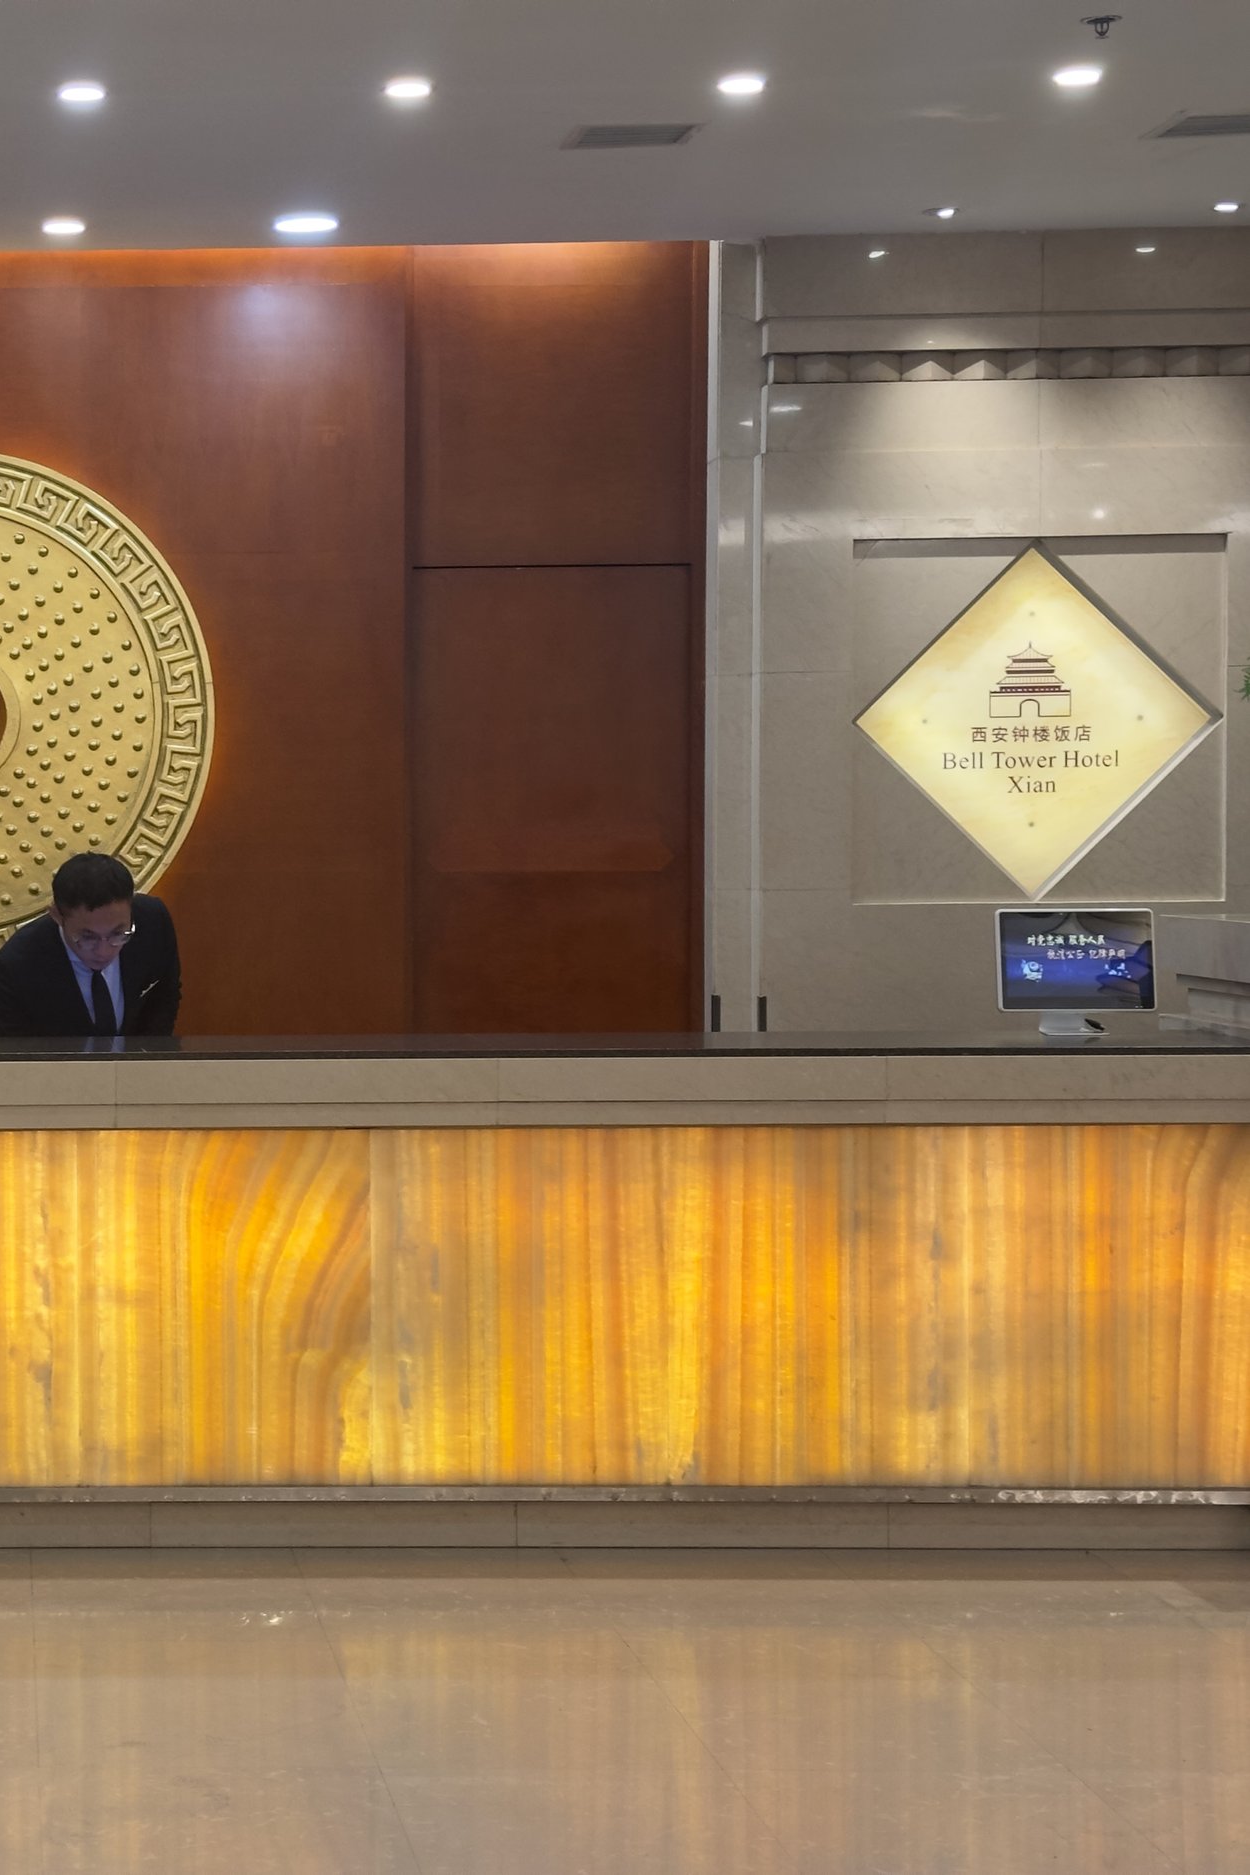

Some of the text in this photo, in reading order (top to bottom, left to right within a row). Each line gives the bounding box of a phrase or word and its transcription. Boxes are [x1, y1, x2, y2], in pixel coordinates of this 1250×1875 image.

[971, 725, 1092, 743] 西安钟楼饭店
[942, 749, 1119, 770] Bell Tower Hotel
[1007, 775, 1056, 794] Xian
